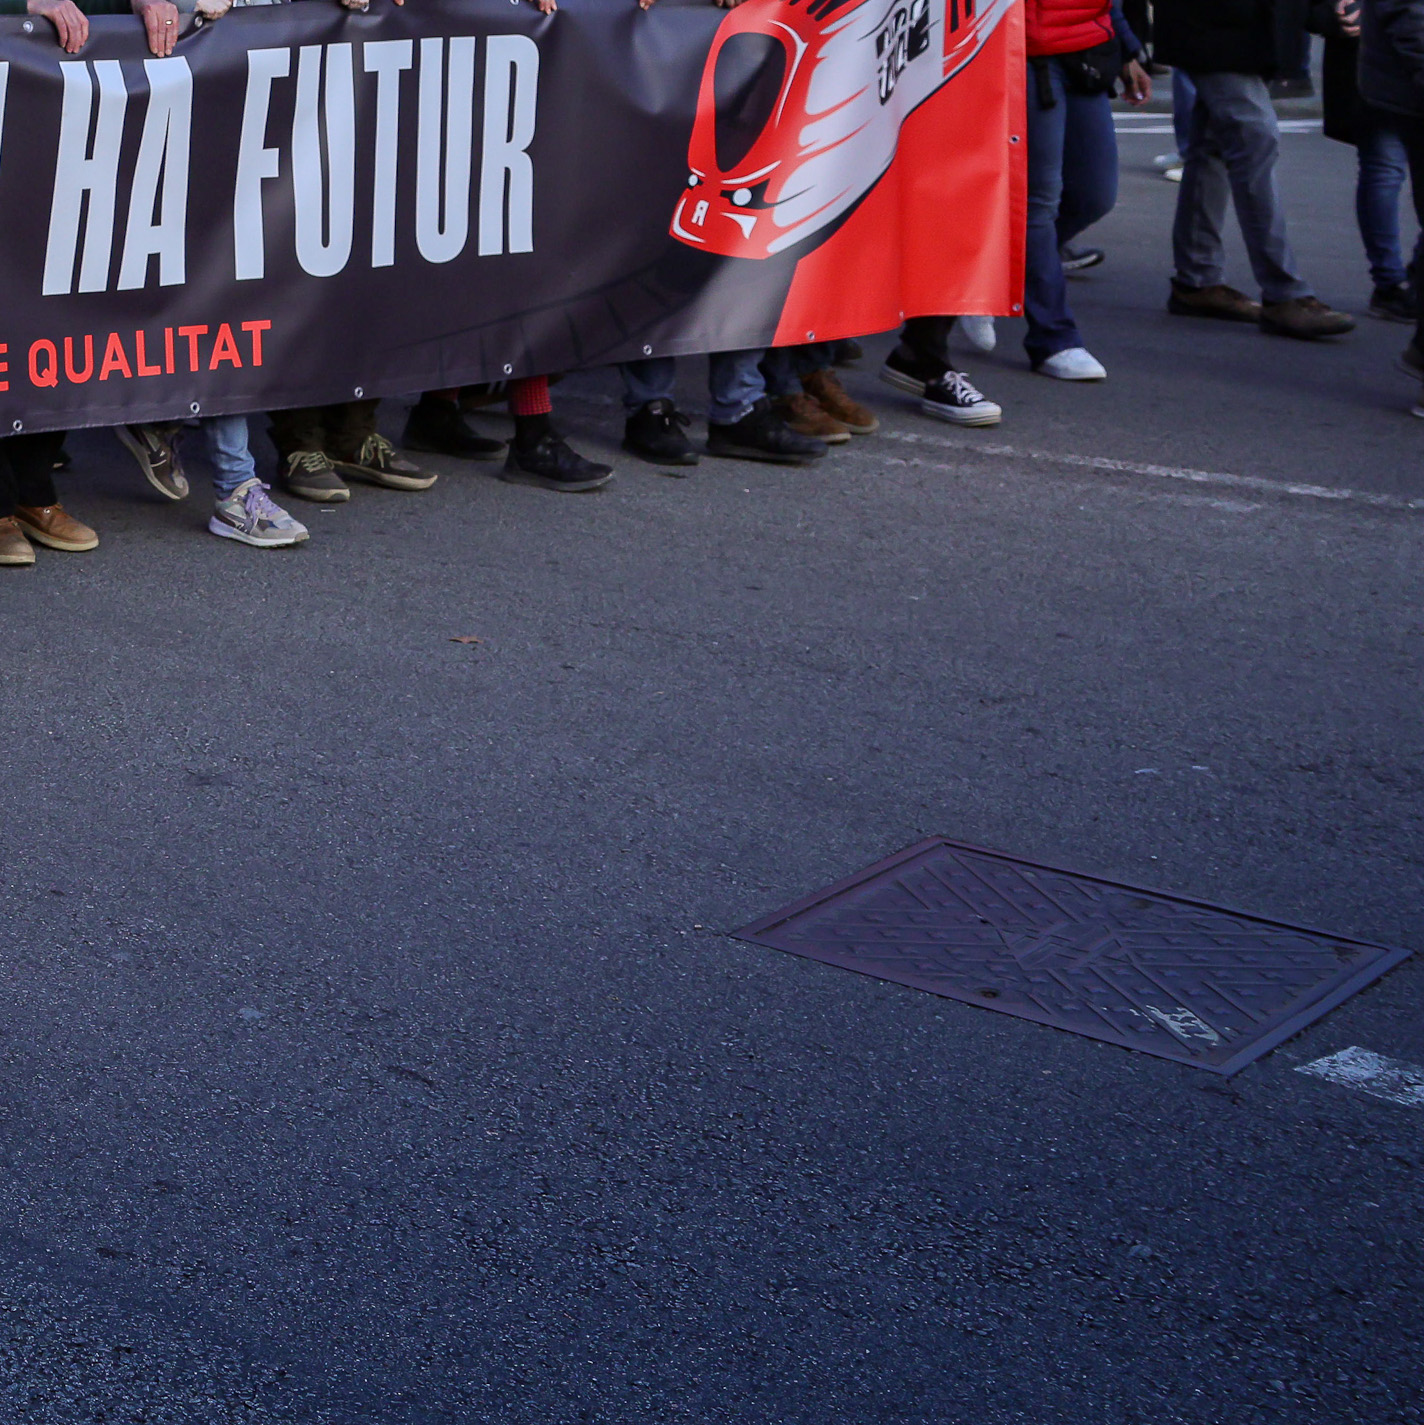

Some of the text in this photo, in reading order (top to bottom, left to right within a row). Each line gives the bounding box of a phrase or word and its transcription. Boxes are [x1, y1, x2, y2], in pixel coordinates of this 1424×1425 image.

[42, 56, 193, 296] HA
[234, 35, 540, 281] FUTUR
[28, 320, 272, 389] QUALITAT
